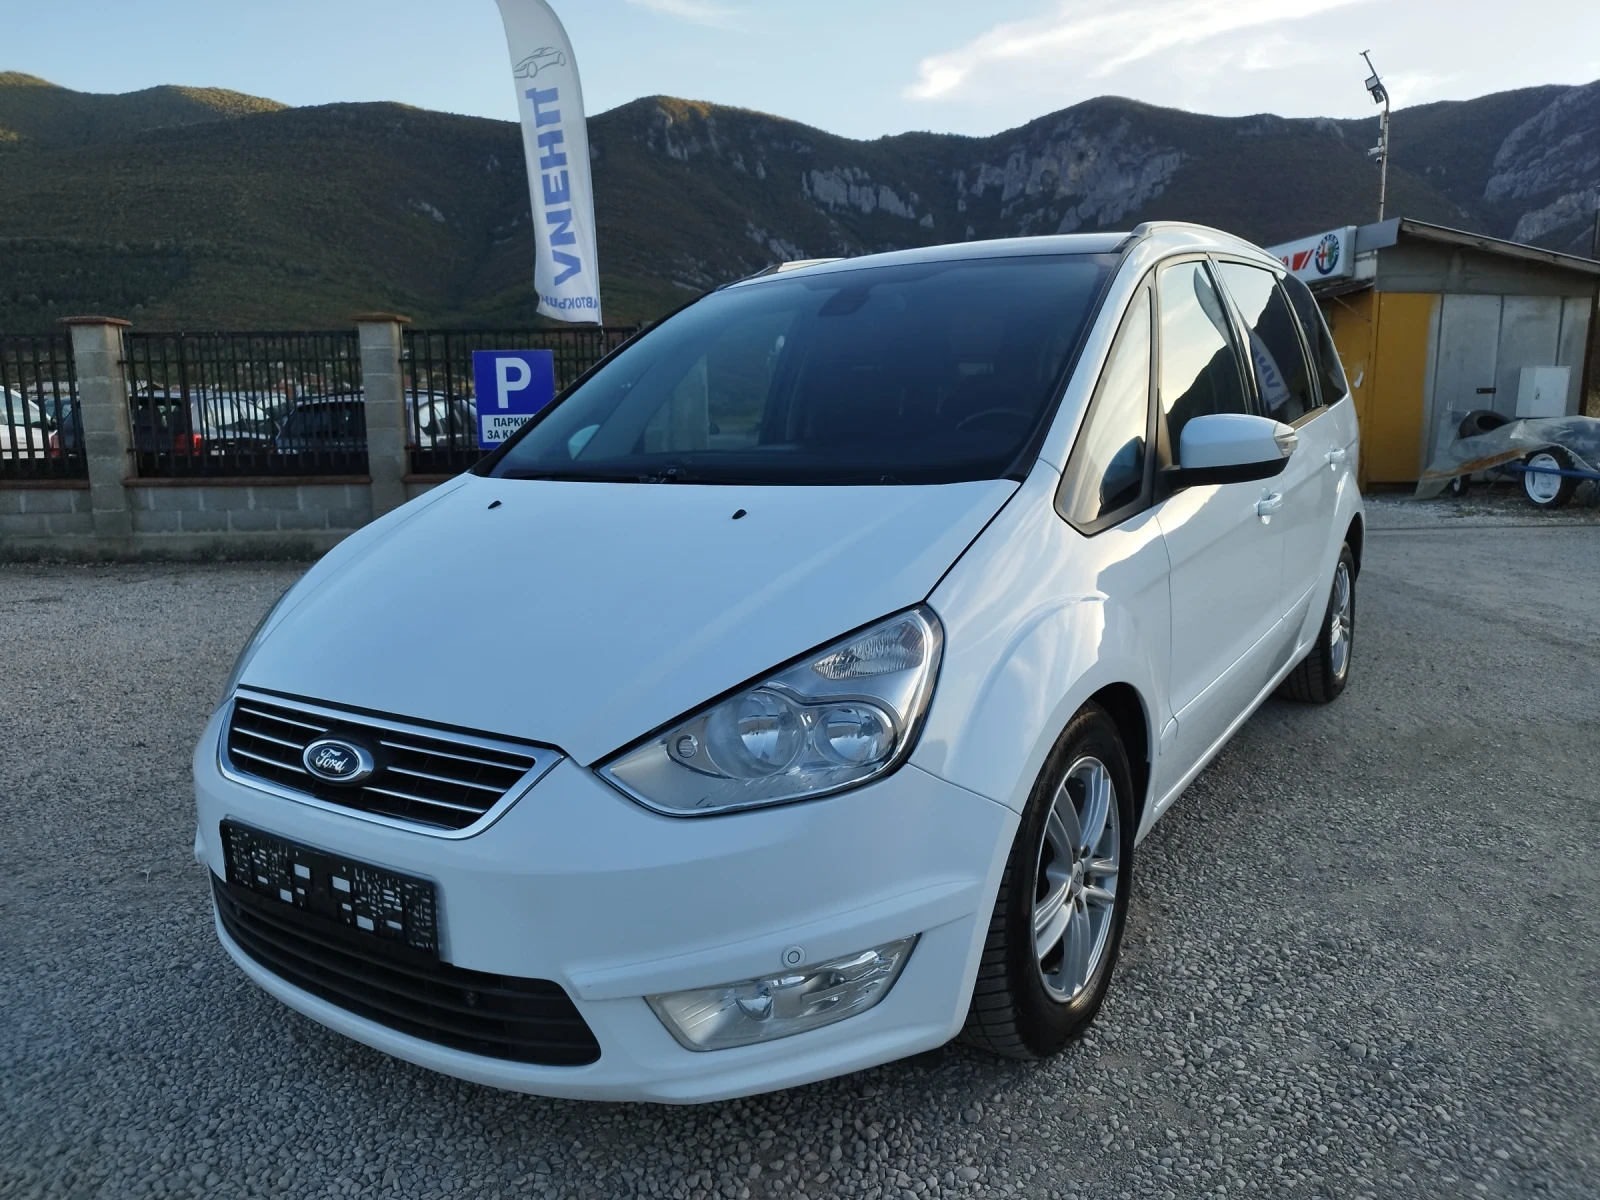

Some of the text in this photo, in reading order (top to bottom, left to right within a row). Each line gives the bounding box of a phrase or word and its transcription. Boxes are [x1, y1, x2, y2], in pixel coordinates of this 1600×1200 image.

[495, 357, 532, 409] P
[493, 417, 531, 427] ПАРКИ
[487, 430, 500, 440] ЗА
[315, 747, 348, 773] Ford
